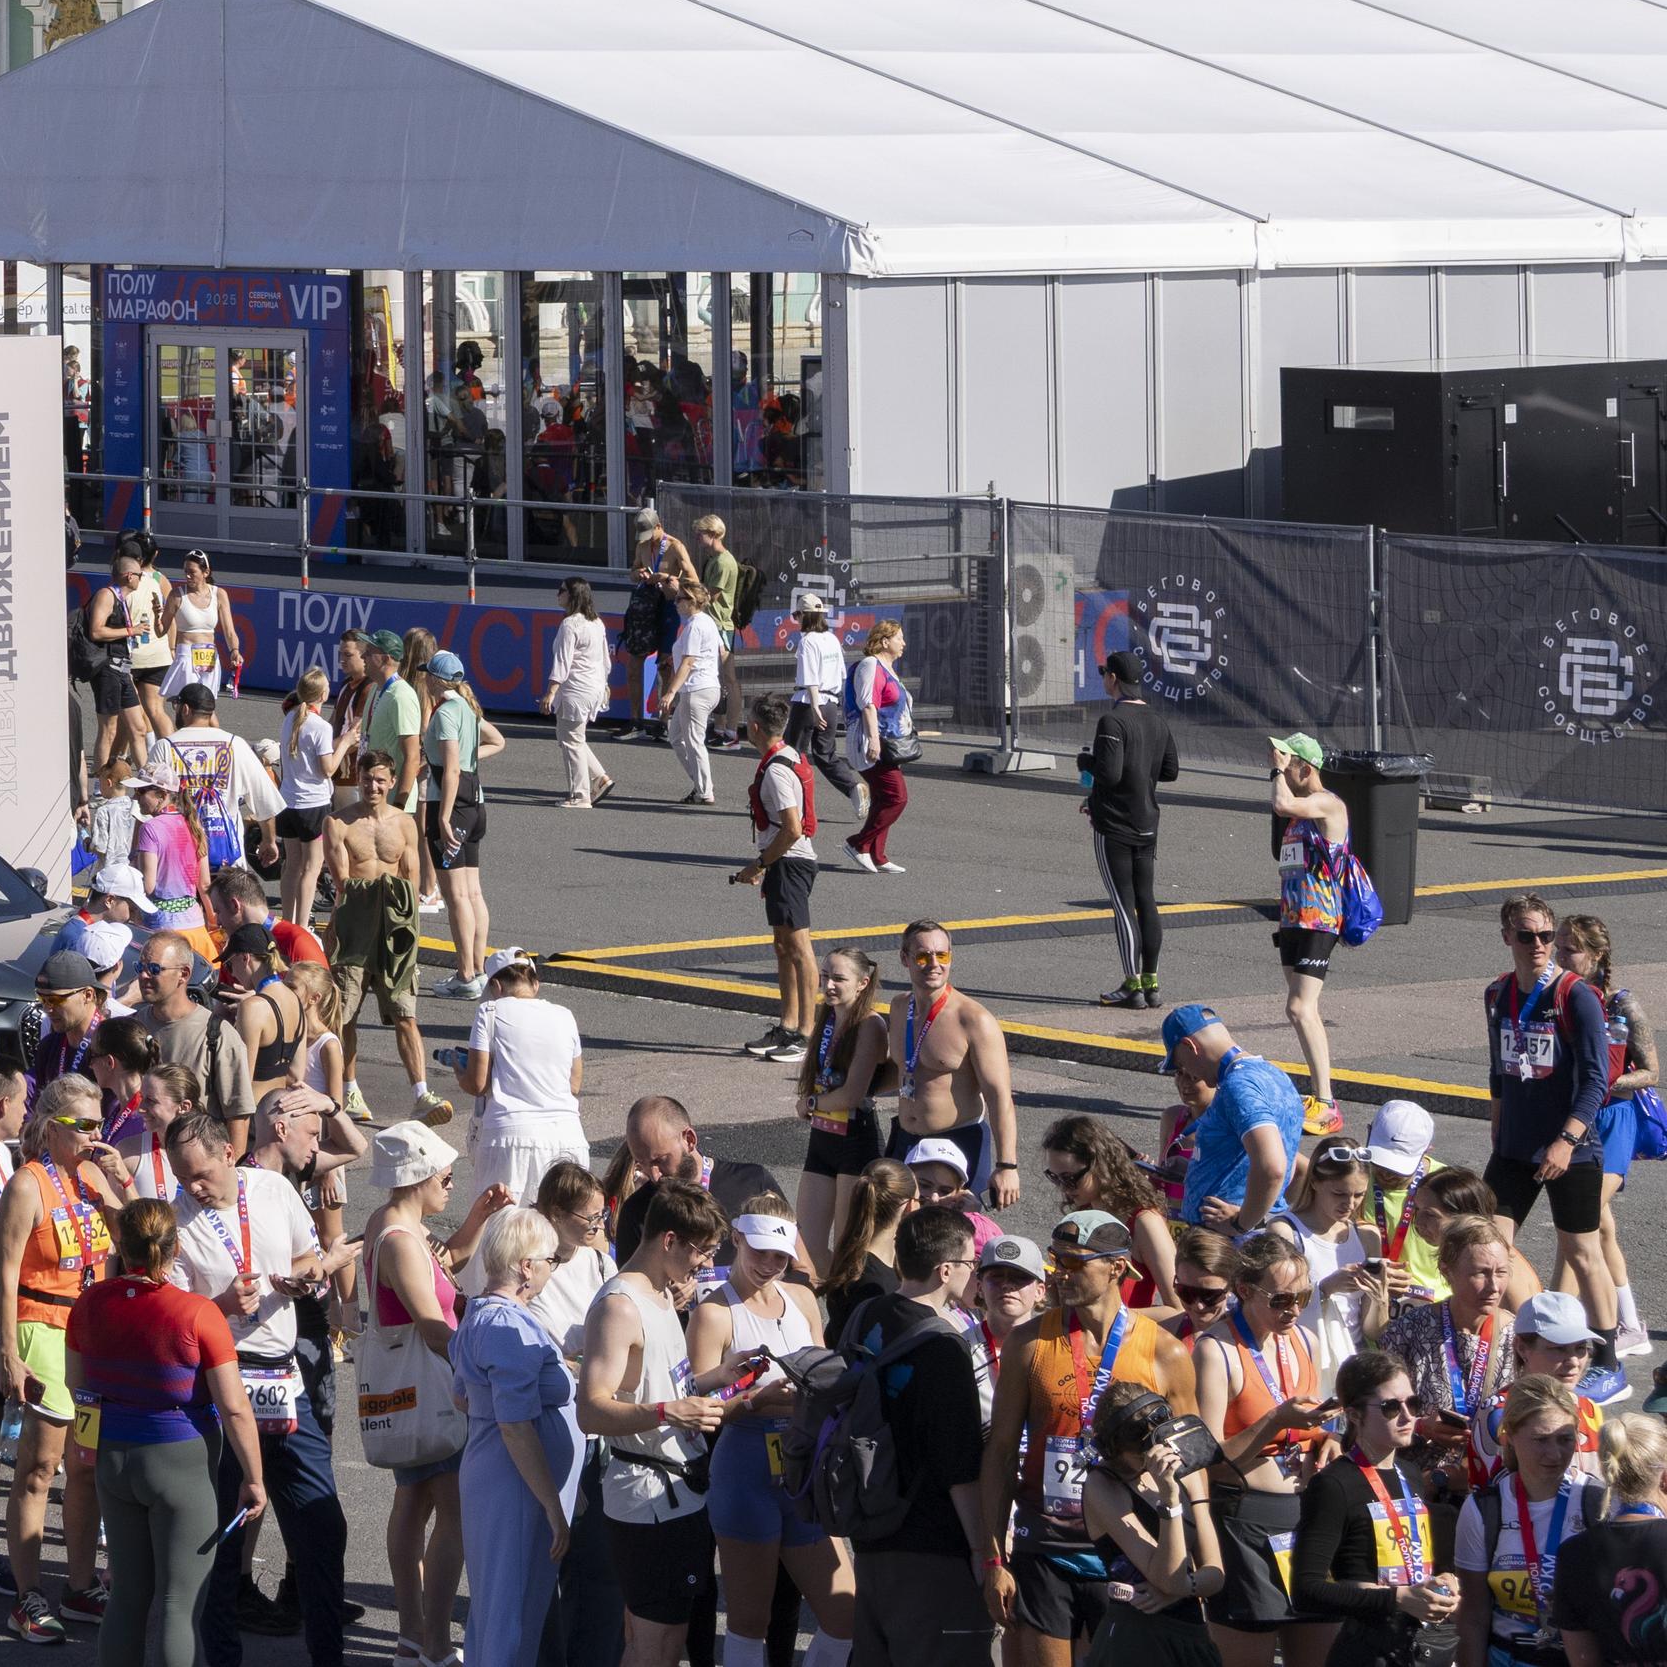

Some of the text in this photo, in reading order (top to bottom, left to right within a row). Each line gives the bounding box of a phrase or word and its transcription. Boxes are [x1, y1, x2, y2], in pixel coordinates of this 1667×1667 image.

[107, 273, 155, 296] ПОЛУ
[248, 291, 282, 300] СЕВЕРНАЯ
[288, 283, 342, 321] VIP
[107, 293, 237, 322] МАРАФОН 2025
[248, 300, 279, 309] СТОЛИЦА
[778, 546, 860, 589] БЕГОВОЕ
[276, 591, 375, 634] ПОЛУ
[1137, 574, 1226, 619] БЕГОВОЕ
[1542, 607, 1648, 656] БЕГОВОЕ
[1132, 645, 1228, 702] СООБЩЕСТВО
[1538, 685, 1652, 745] СООБЩЕСТВО
[1093, 1367, 1113, 1394] KM
[1466, 1340, 1488, 1409] ПОЛУМАРАФОН
[1411, 1540, 1424, 1565] KM
[1388, 1567, 1398, 1582] E
